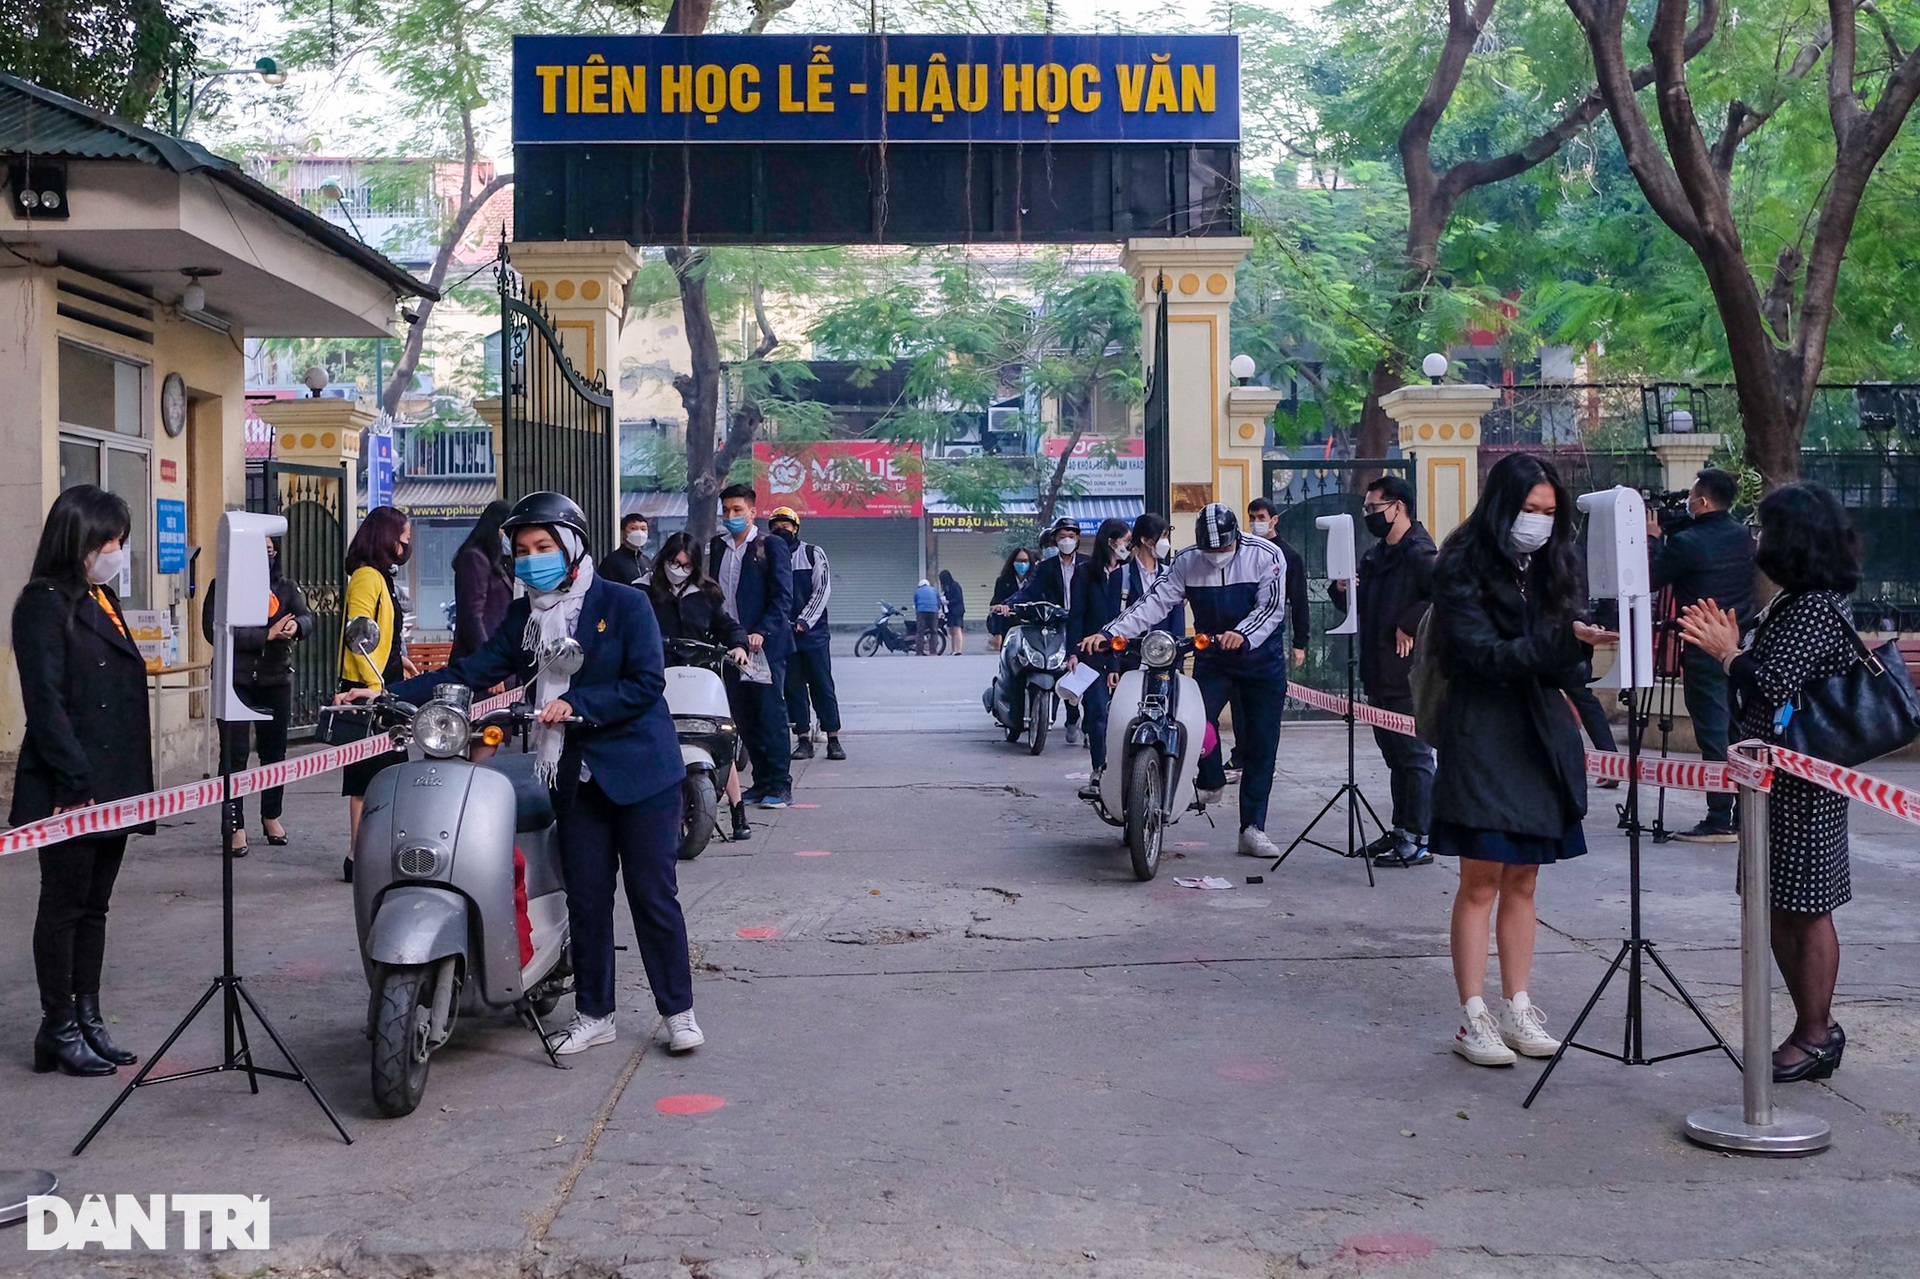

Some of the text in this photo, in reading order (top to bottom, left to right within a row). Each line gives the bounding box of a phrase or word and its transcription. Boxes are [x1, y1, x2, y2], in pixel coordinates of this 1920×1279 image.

[536, 45, 1216, 123] TIÊN HỌC LỄ - HẬU HỌC VĂN
[811, 458, 907, 481] MUE
[933, 515, 955, 526] BÚN
[958, 515, 981, 528] ĐẬU
